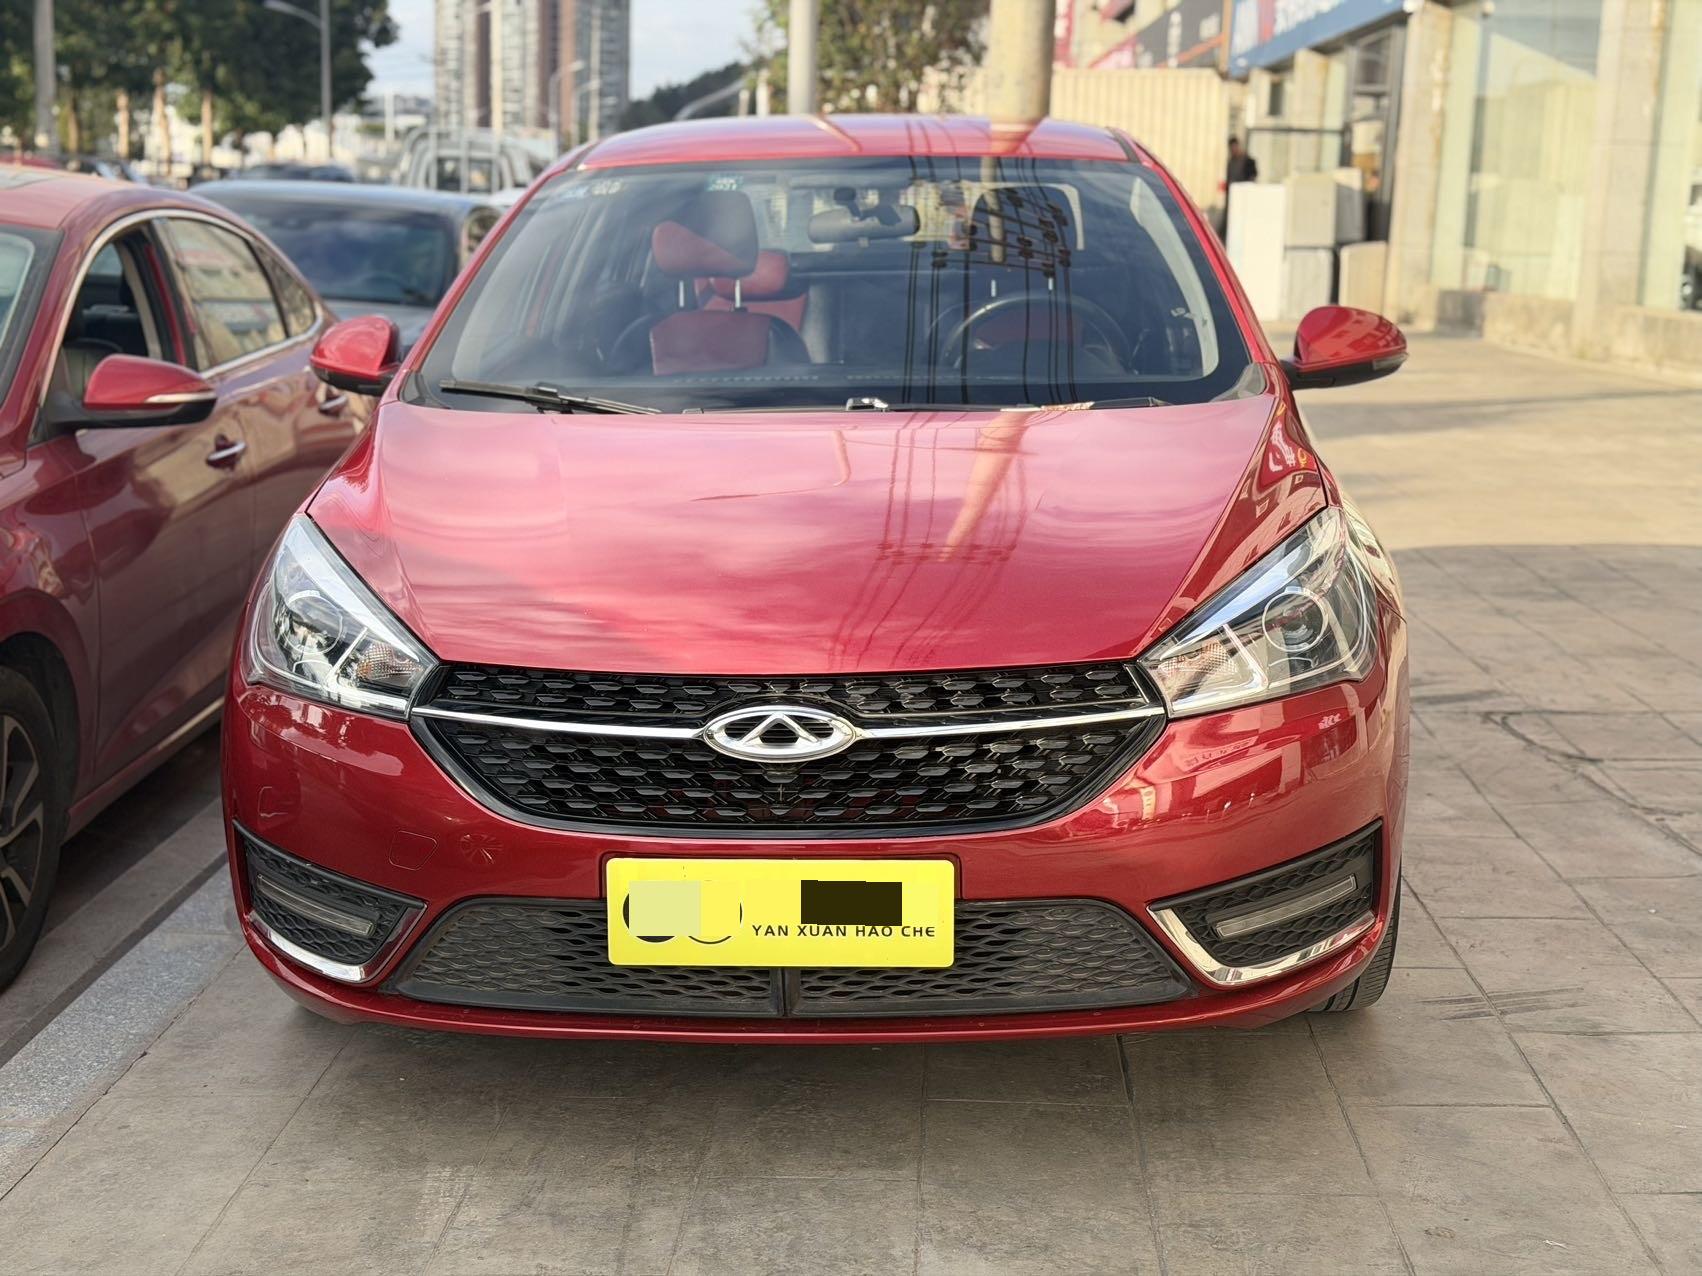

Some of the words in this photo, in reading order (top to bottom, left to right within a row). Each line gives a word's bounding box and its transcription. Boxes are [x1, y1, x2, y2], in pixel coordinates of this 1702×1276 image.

[752, 925, 789, 937] YAN
[797, 925, 847, 937] XUAN
[855, 925, 893, 937] HAO
[901, 926, 935, 937] CHE
